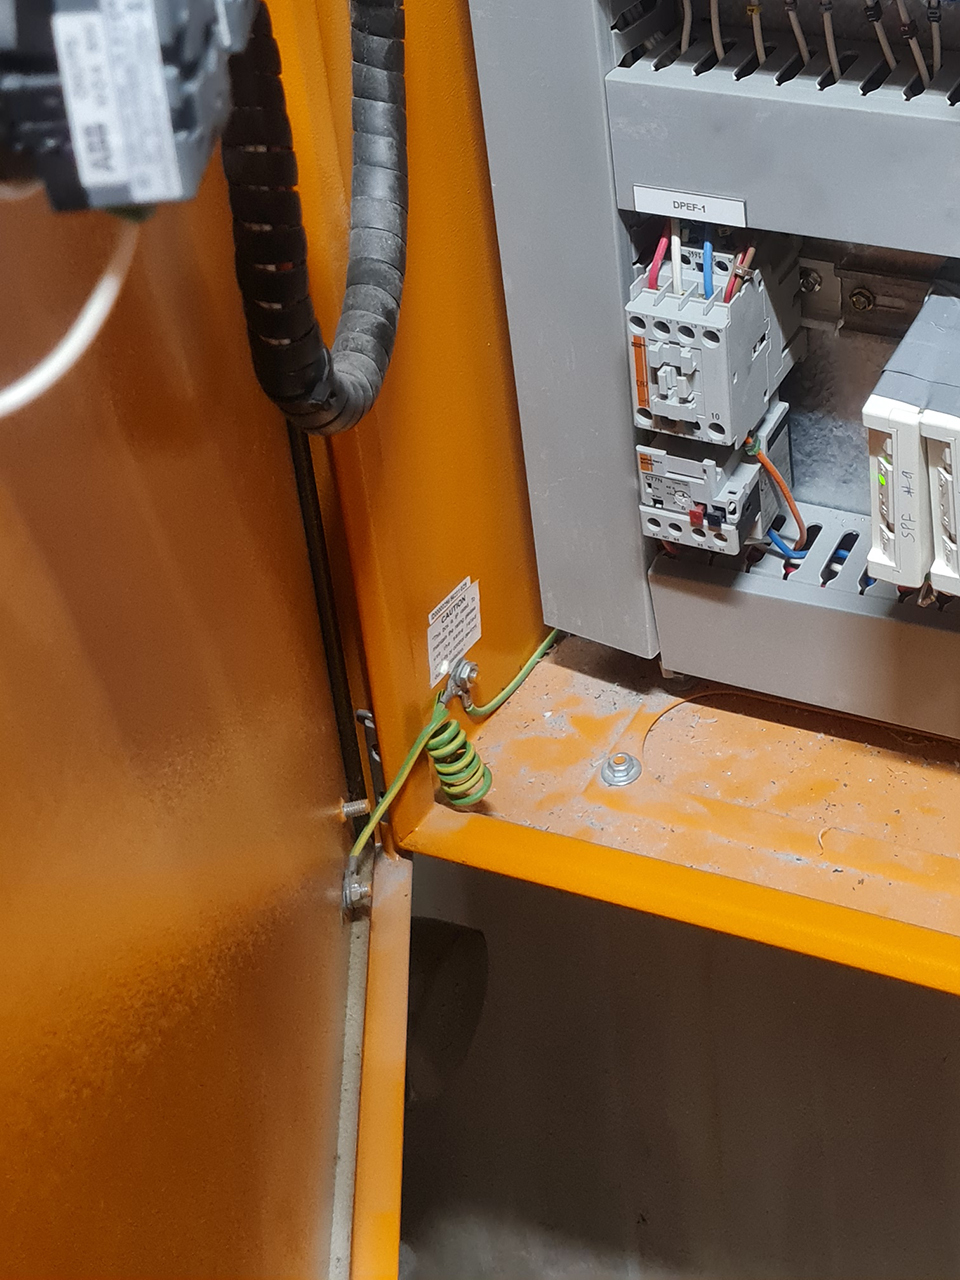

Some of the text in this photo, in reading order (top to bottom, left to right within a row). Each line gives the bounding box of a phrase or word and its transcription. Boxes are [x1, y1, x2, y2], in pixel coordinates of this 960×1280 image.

[672, 199, 706, 214] DPEF-1
[901, 514, 916, 543] SPF
[440, 595, 466, 623] CAUTION
